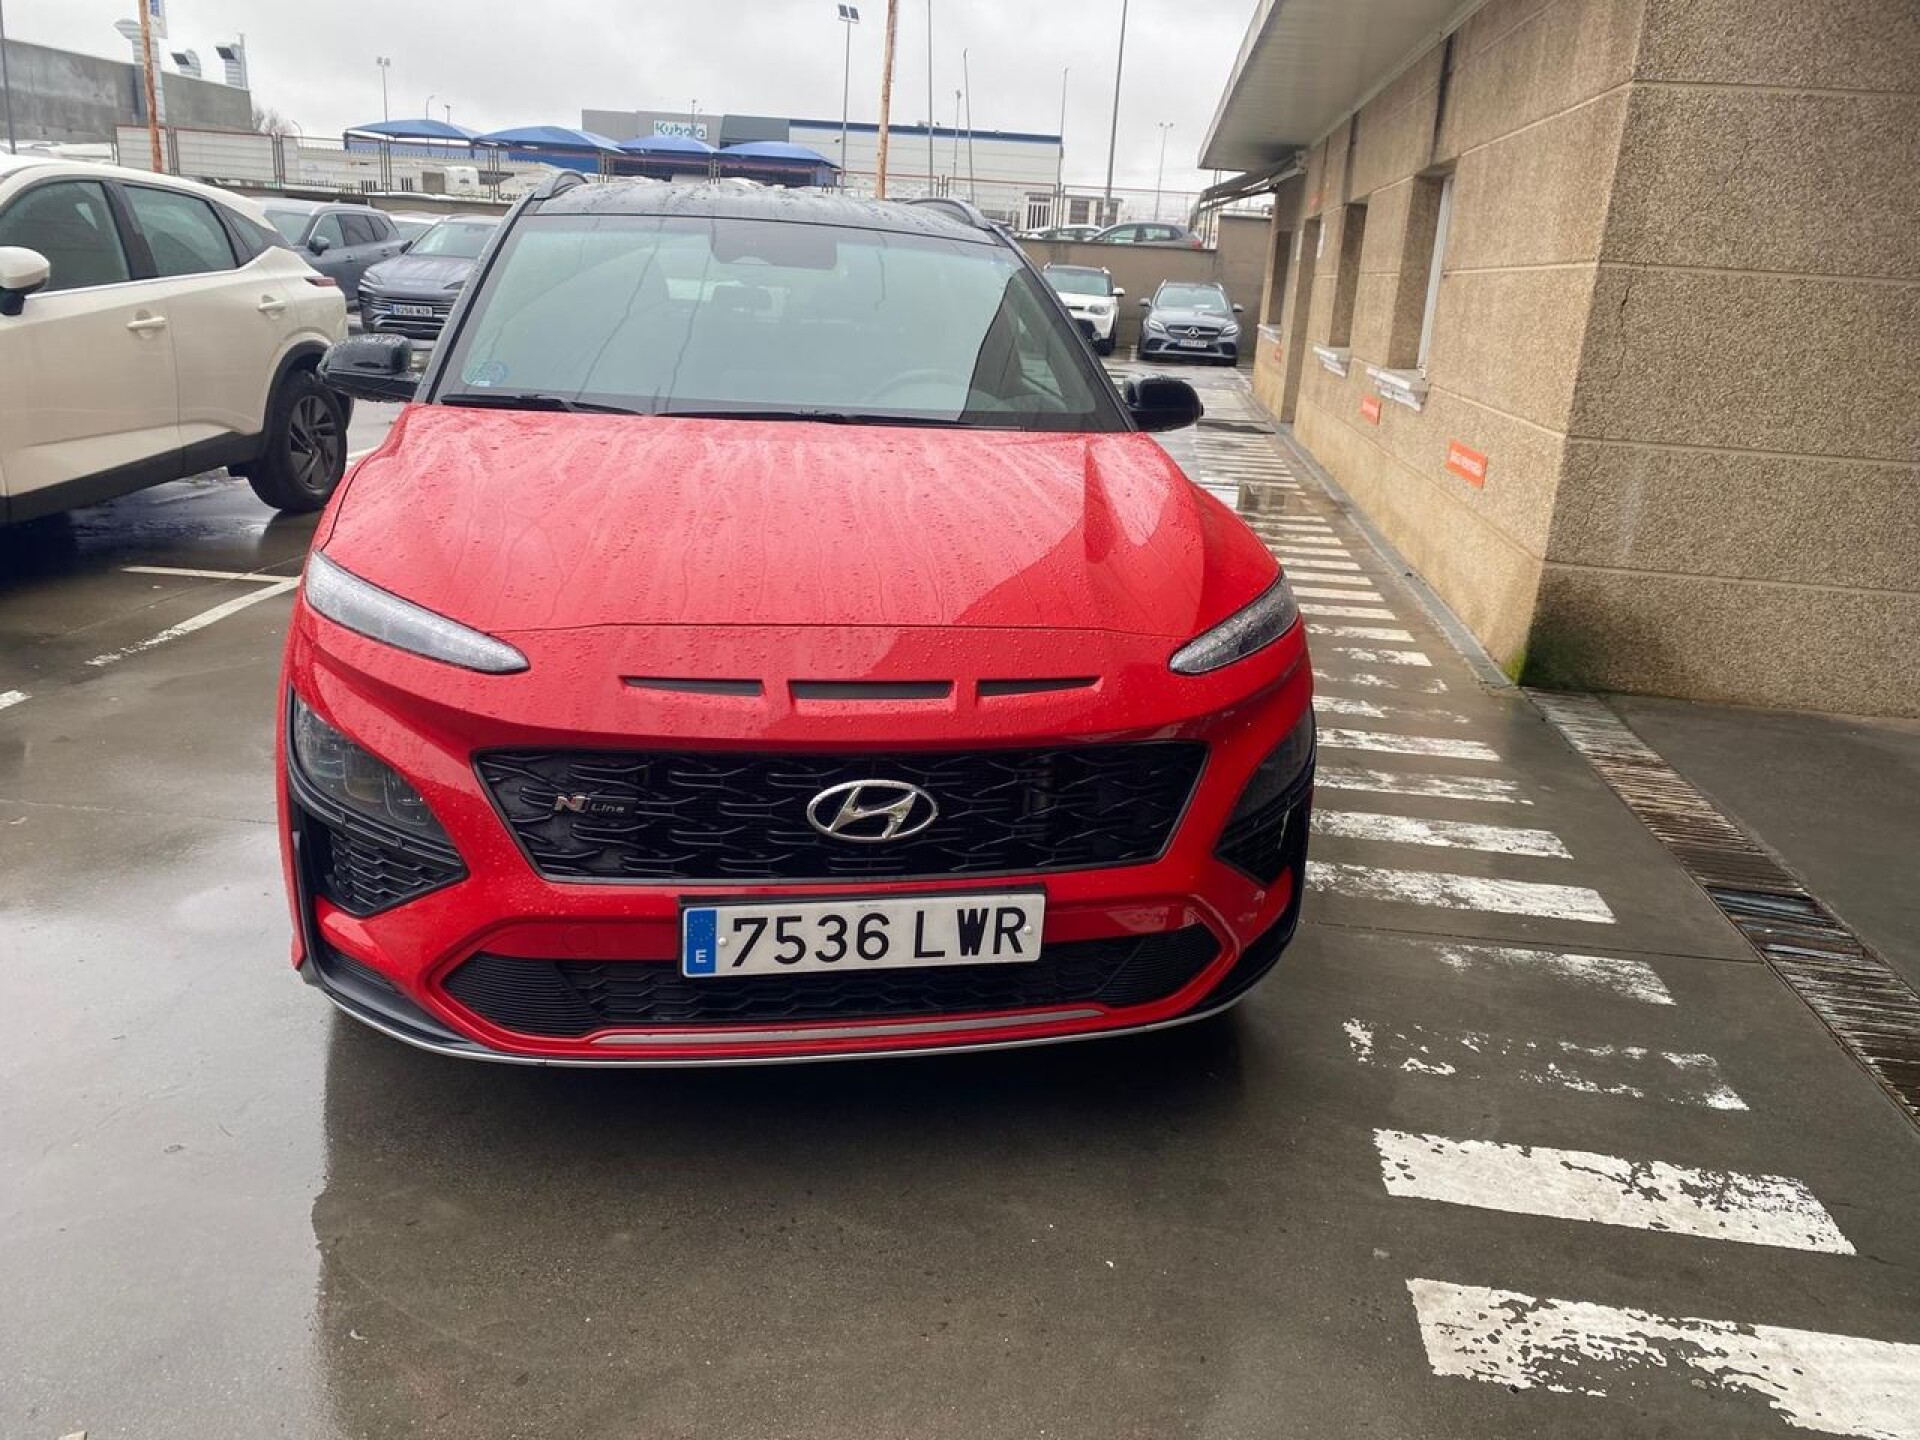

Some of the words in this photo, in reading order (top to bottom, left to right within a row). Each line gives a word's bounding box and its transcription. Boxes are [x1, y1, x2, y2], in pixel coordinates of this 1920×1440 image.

[695, 950, 707, 963] E
[732, 913, 890, 967] 7536
[914, 907, 1026, 958] LWR
